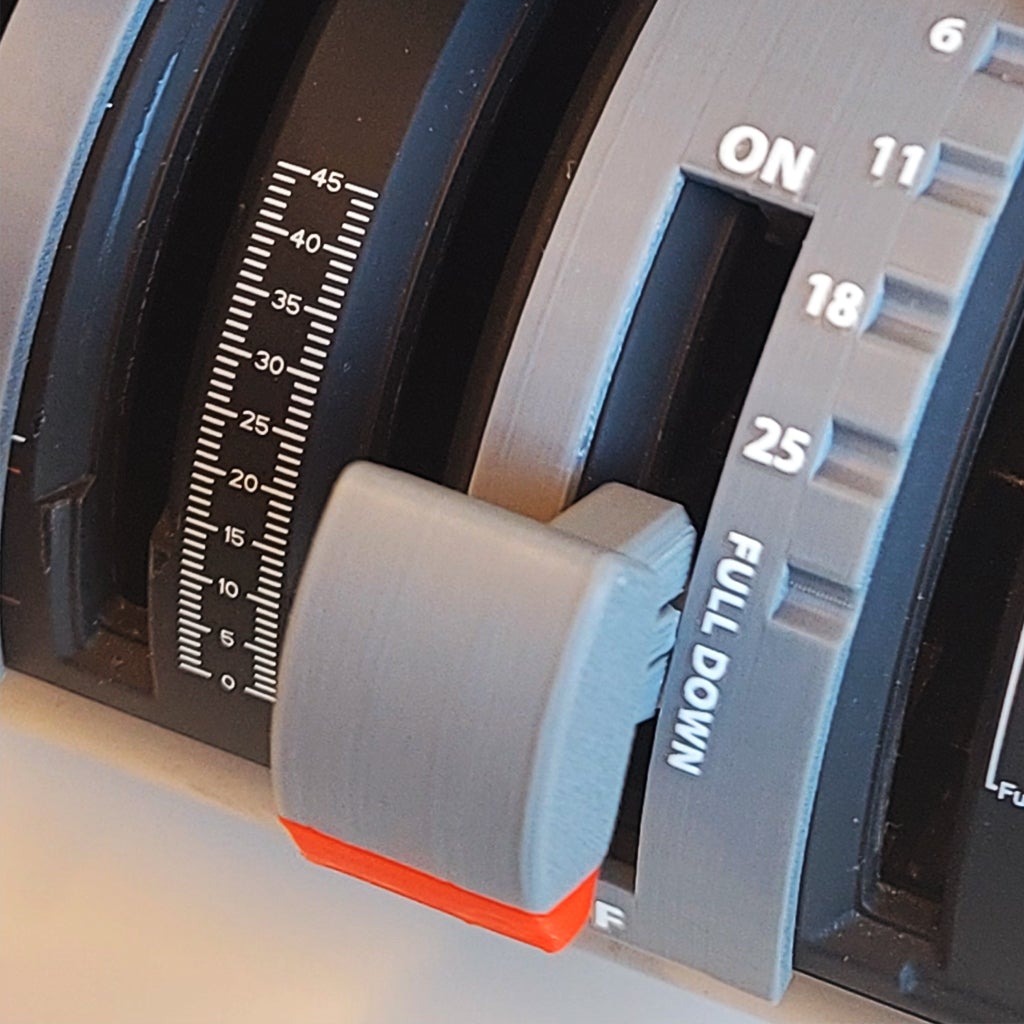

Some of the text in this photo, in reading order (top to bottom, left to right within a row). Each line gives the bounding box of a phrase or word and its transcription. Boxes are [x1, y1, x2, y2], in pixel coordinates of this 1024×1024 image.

[929, 17, 967, 54] 6
[718, 125, 816, 193] ON
[870, 135, 926, 188] 11
[310, 168, 345, 193] 45
[289, 228, 321, 254] 40
[270, 289, 303, 316] 35
[807, 272, 865, 329] 18
[254, 350, 285, 376] 30
[239, 409, 271, 436] 25
[742, 416, 812, 475] 25
[228, 468, 259, 494] 20
[224, 525, 246, 548] 15
[217, 577, 239, 599] 10
[219, 628, 236, 648] 5
[667, 530, 766, 777] FULL DOWN
[220, 674, 237, 691] 0
